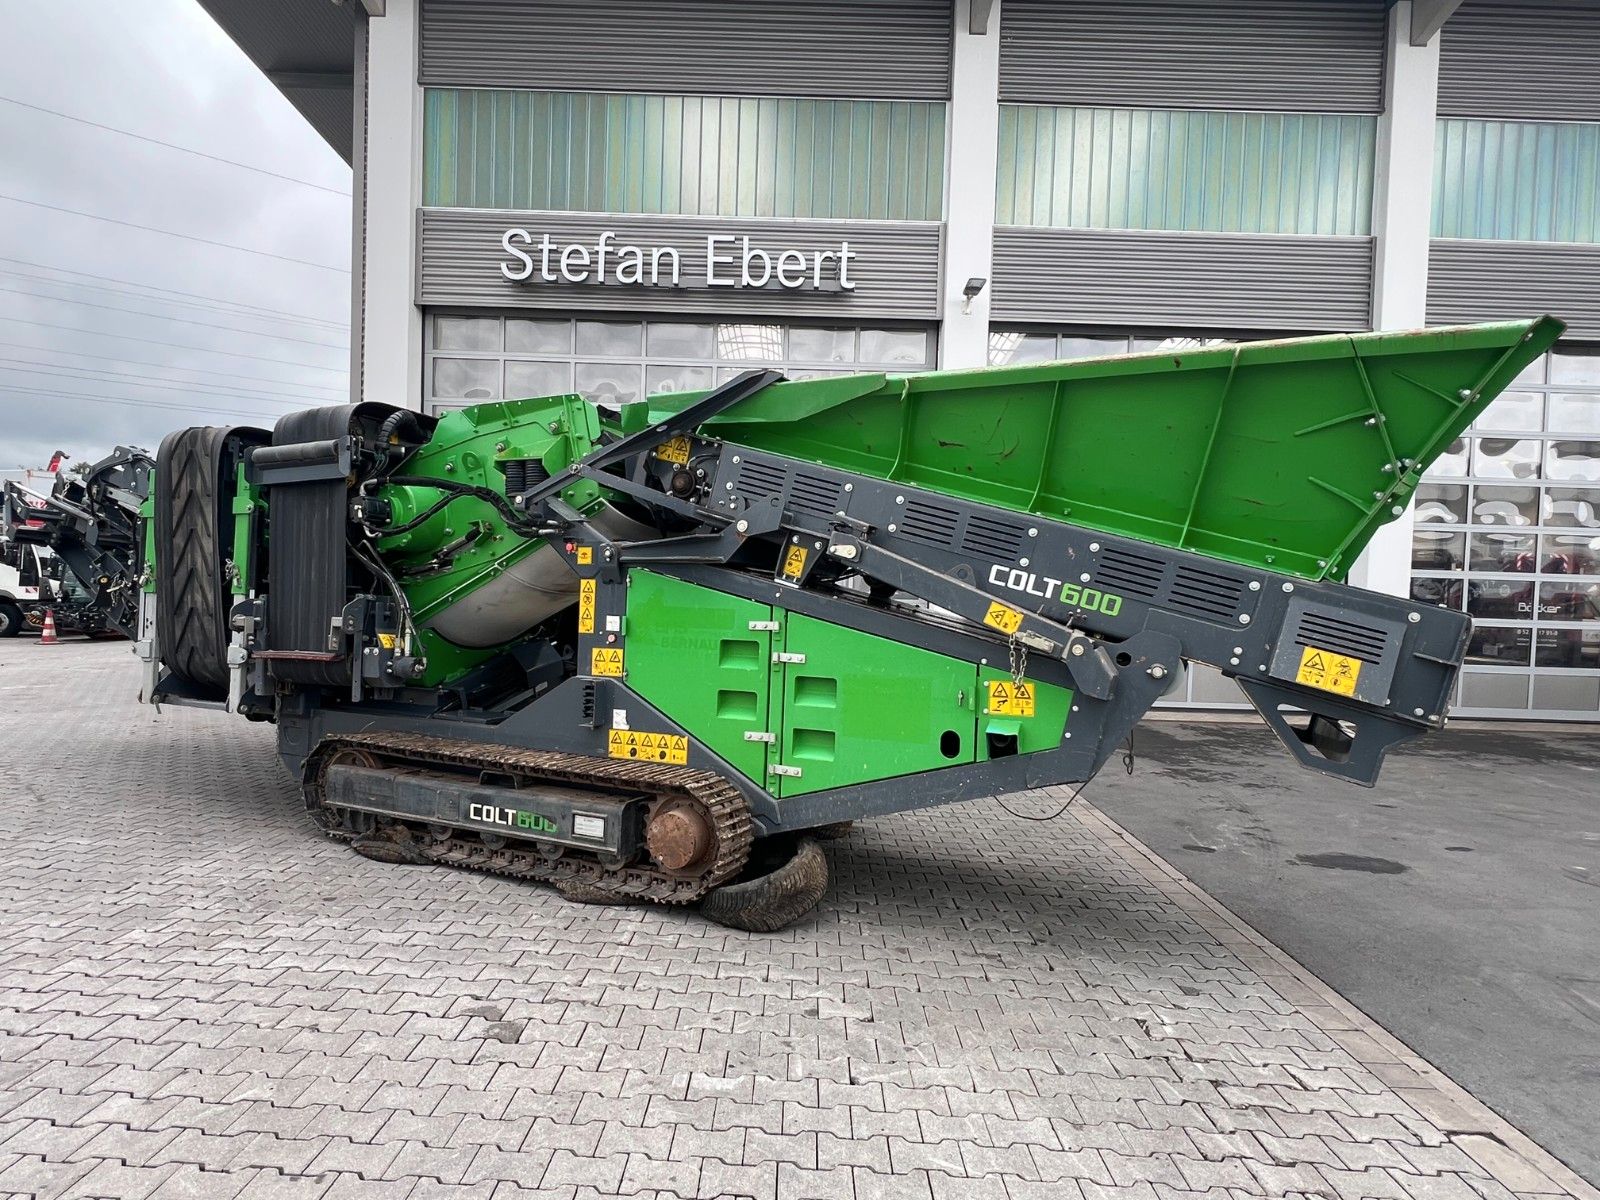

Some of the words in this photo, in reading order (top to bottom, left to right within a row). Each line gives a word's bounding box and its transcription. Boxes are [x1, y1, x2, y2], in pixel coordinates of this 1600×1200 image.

[500, 228, 680, 285] Stefan
[706, 235, 856, 289] Ebert
[988, 564, 1123, 617] COLT600
